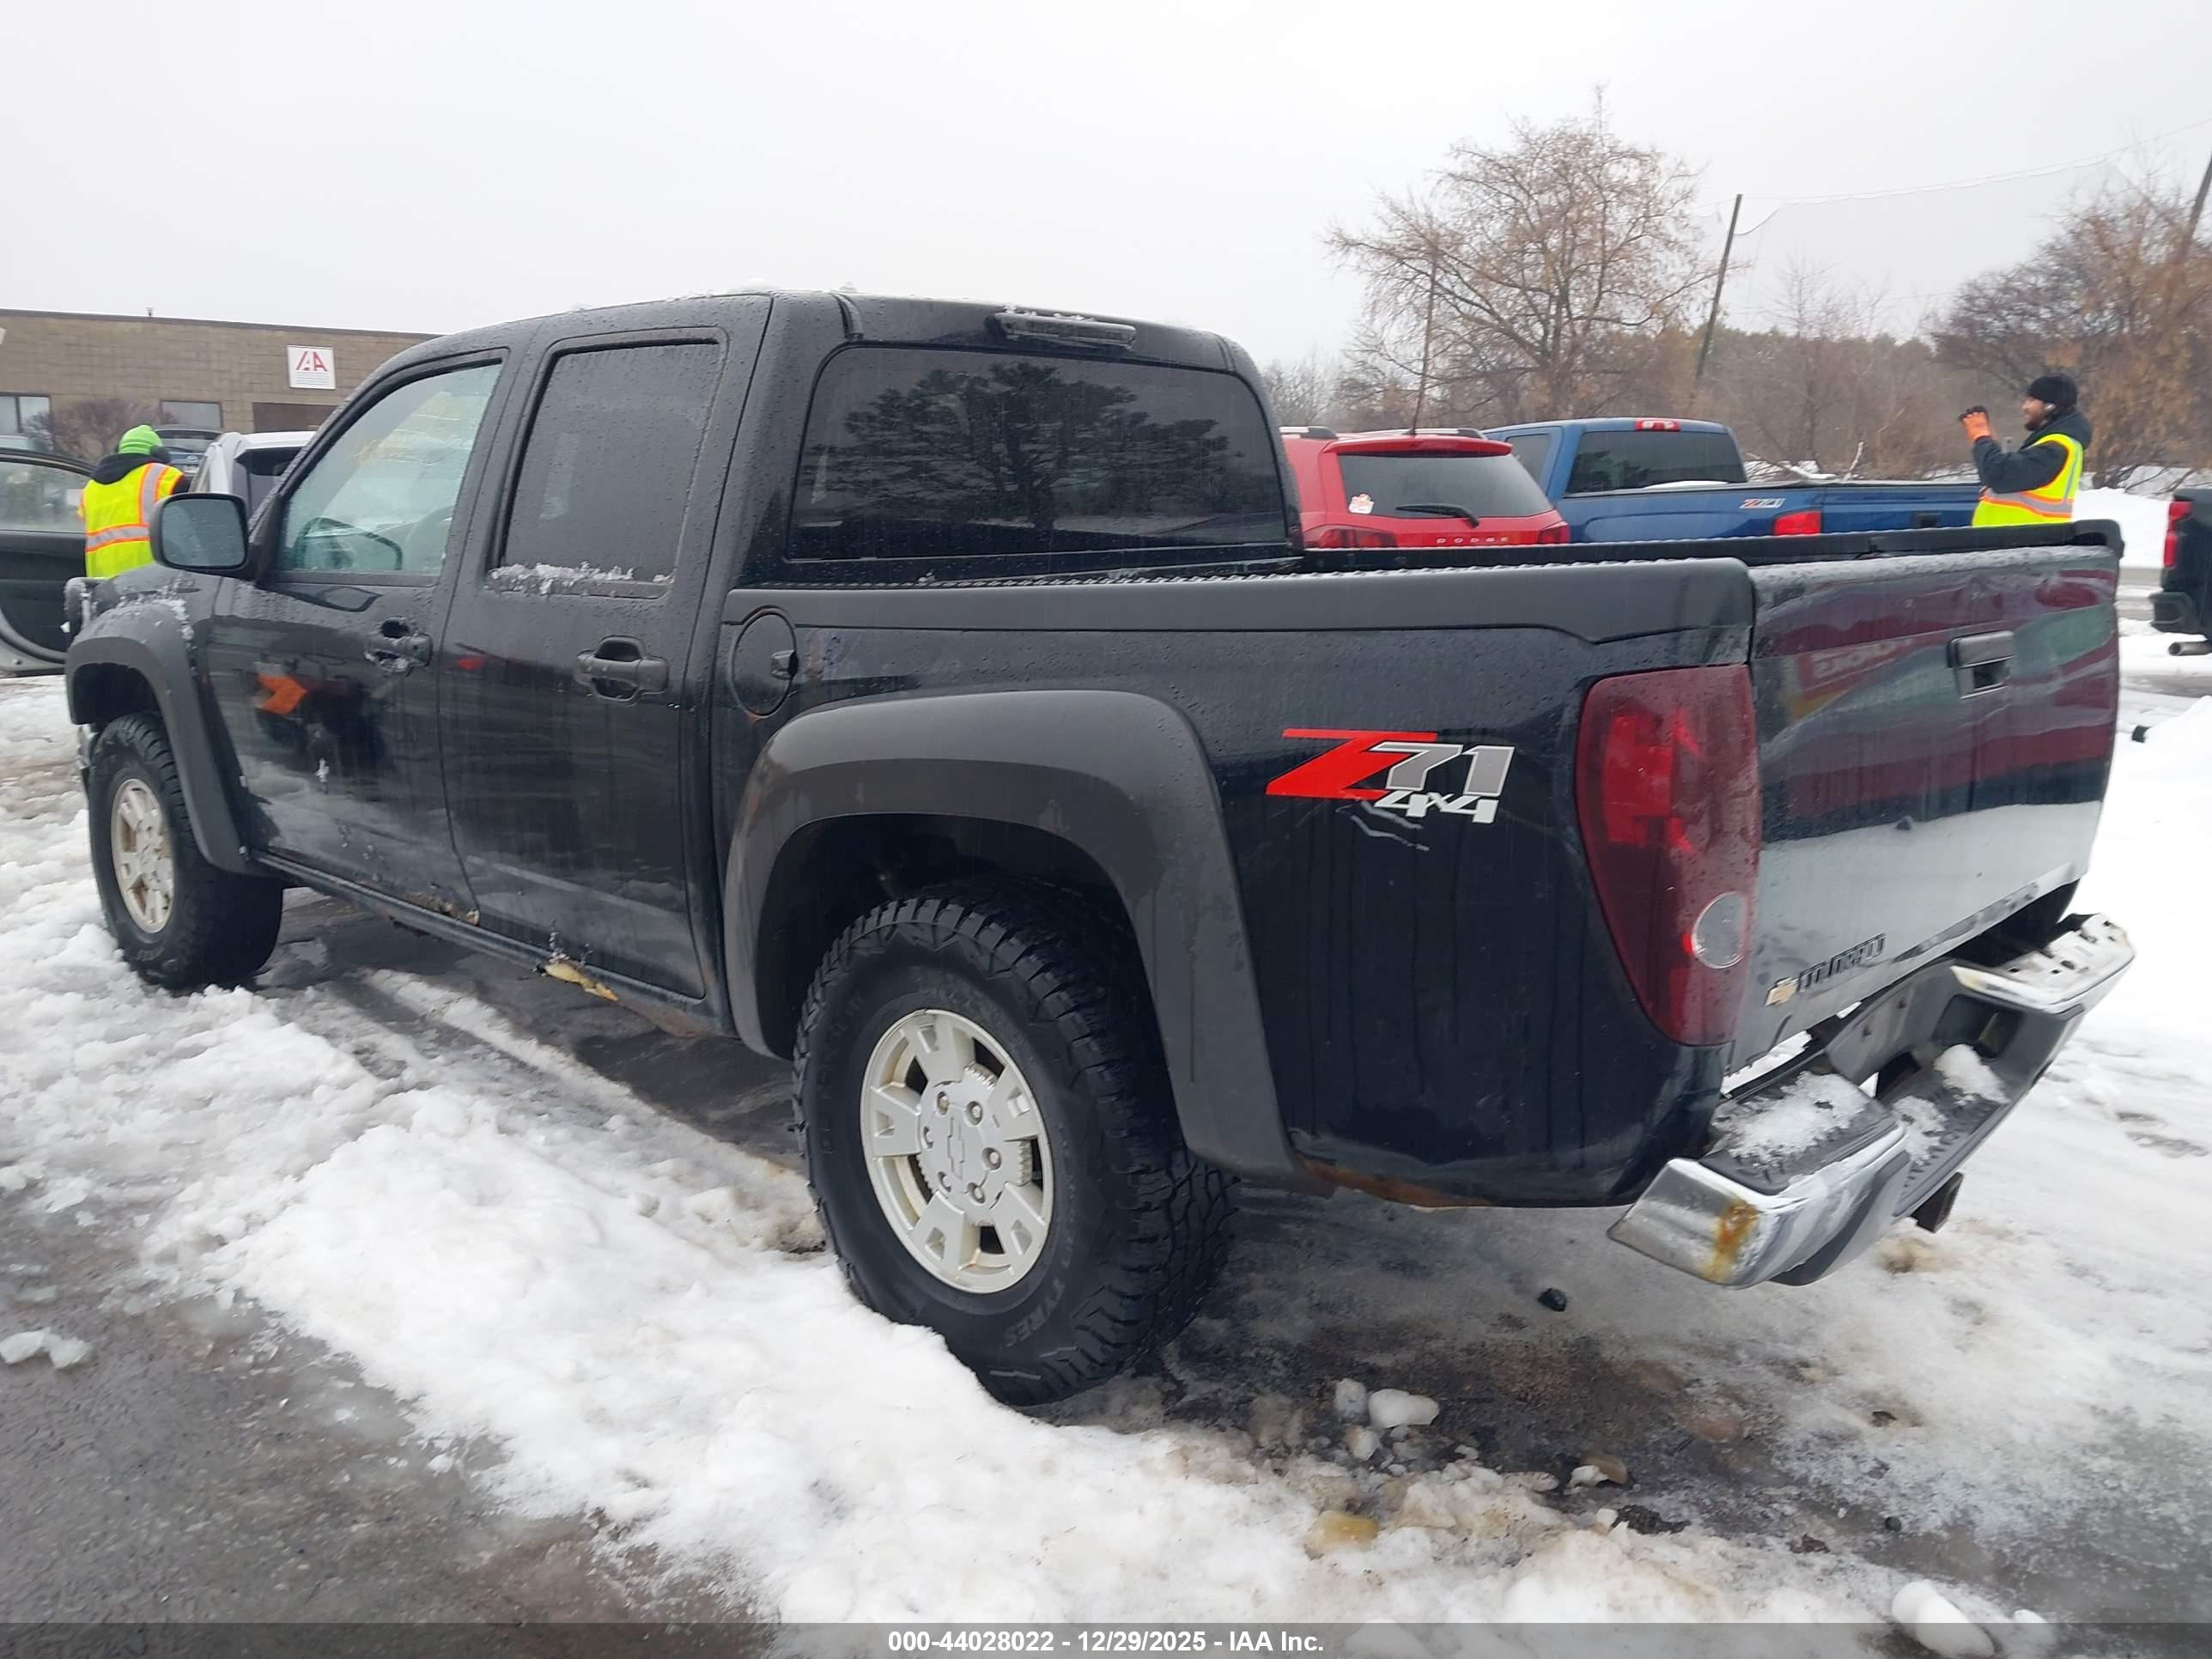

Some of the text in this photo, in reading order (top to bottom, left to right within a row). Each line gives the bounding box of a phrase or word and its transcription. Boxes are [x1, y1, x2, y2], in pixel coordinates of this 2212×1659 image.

[295, 350, 328, 372] IAA
[1436, 536, 1509, 544] DODGE
[1265, 727, 1516, 801] Z71
